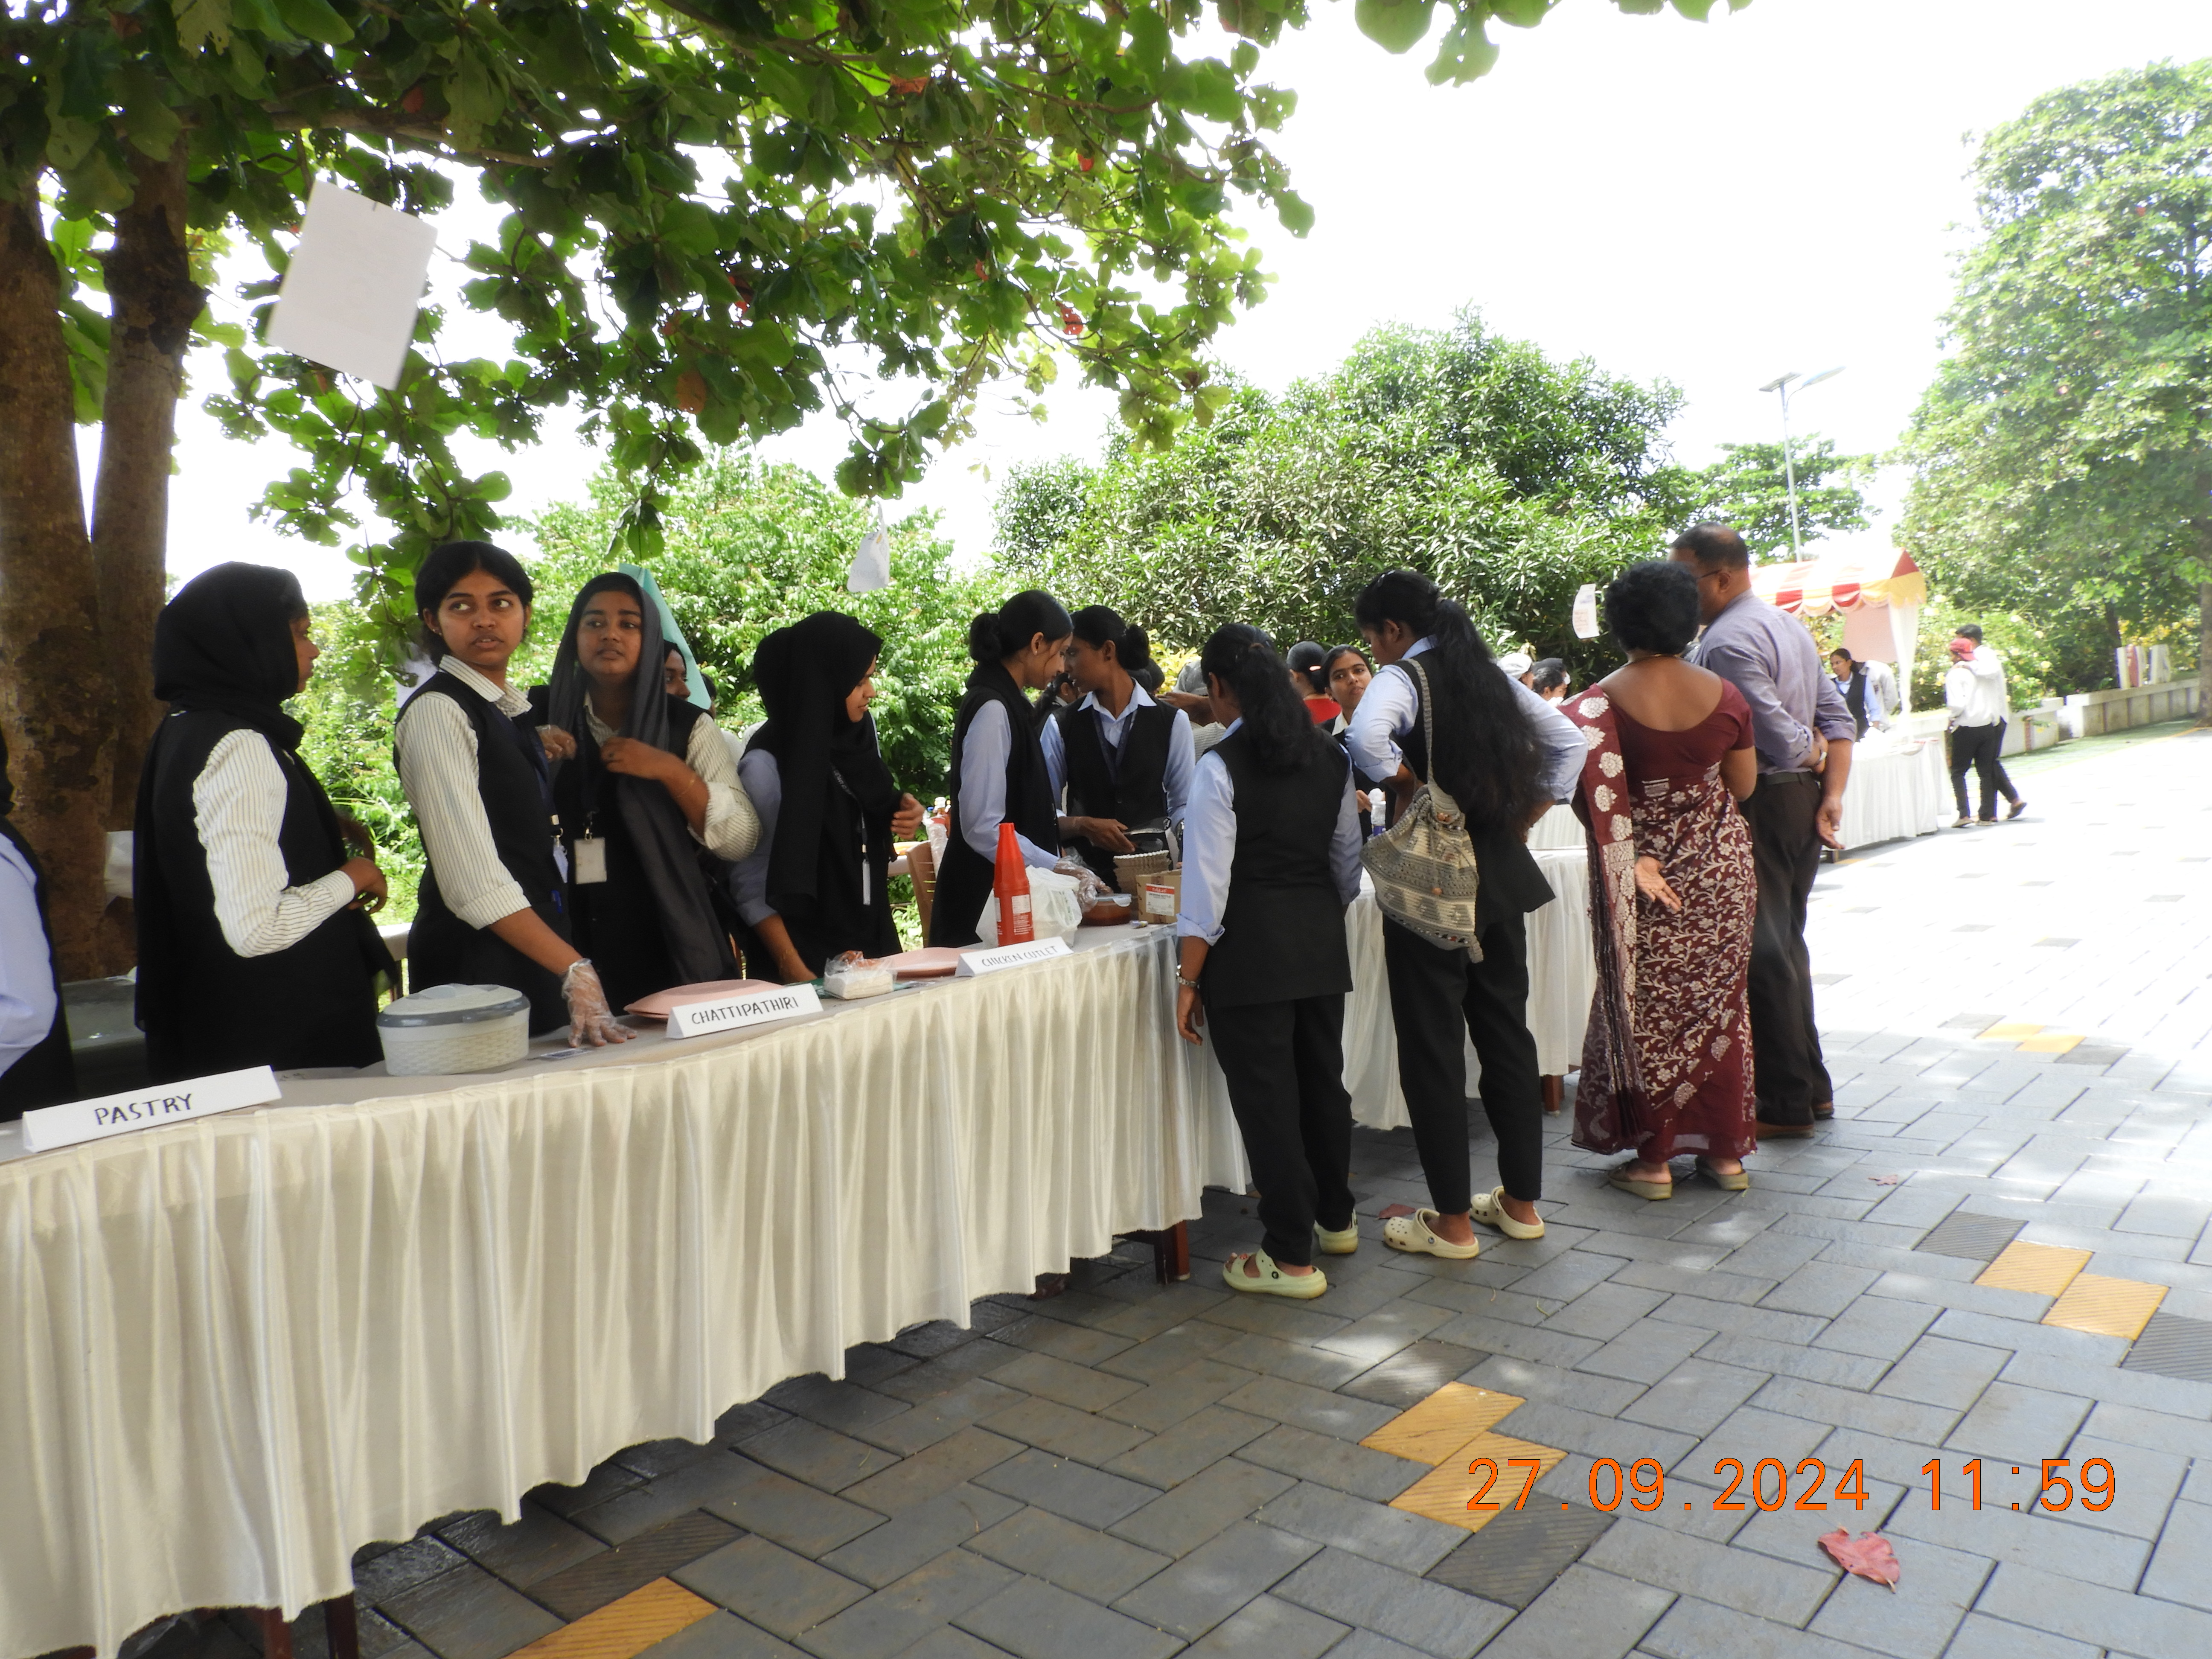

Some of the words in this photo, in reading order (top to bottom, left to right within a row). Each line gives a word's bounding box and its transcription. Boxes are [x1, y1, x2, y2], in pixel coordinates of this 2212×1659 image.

[982, 953, 1023, 967] CHICKEN
[1024, 946, 1058, 959] CUTLET
[692, 996, 799, 1024] CHATTIPATHIRI
[94, 1093, 192, 1125] PASTRY
